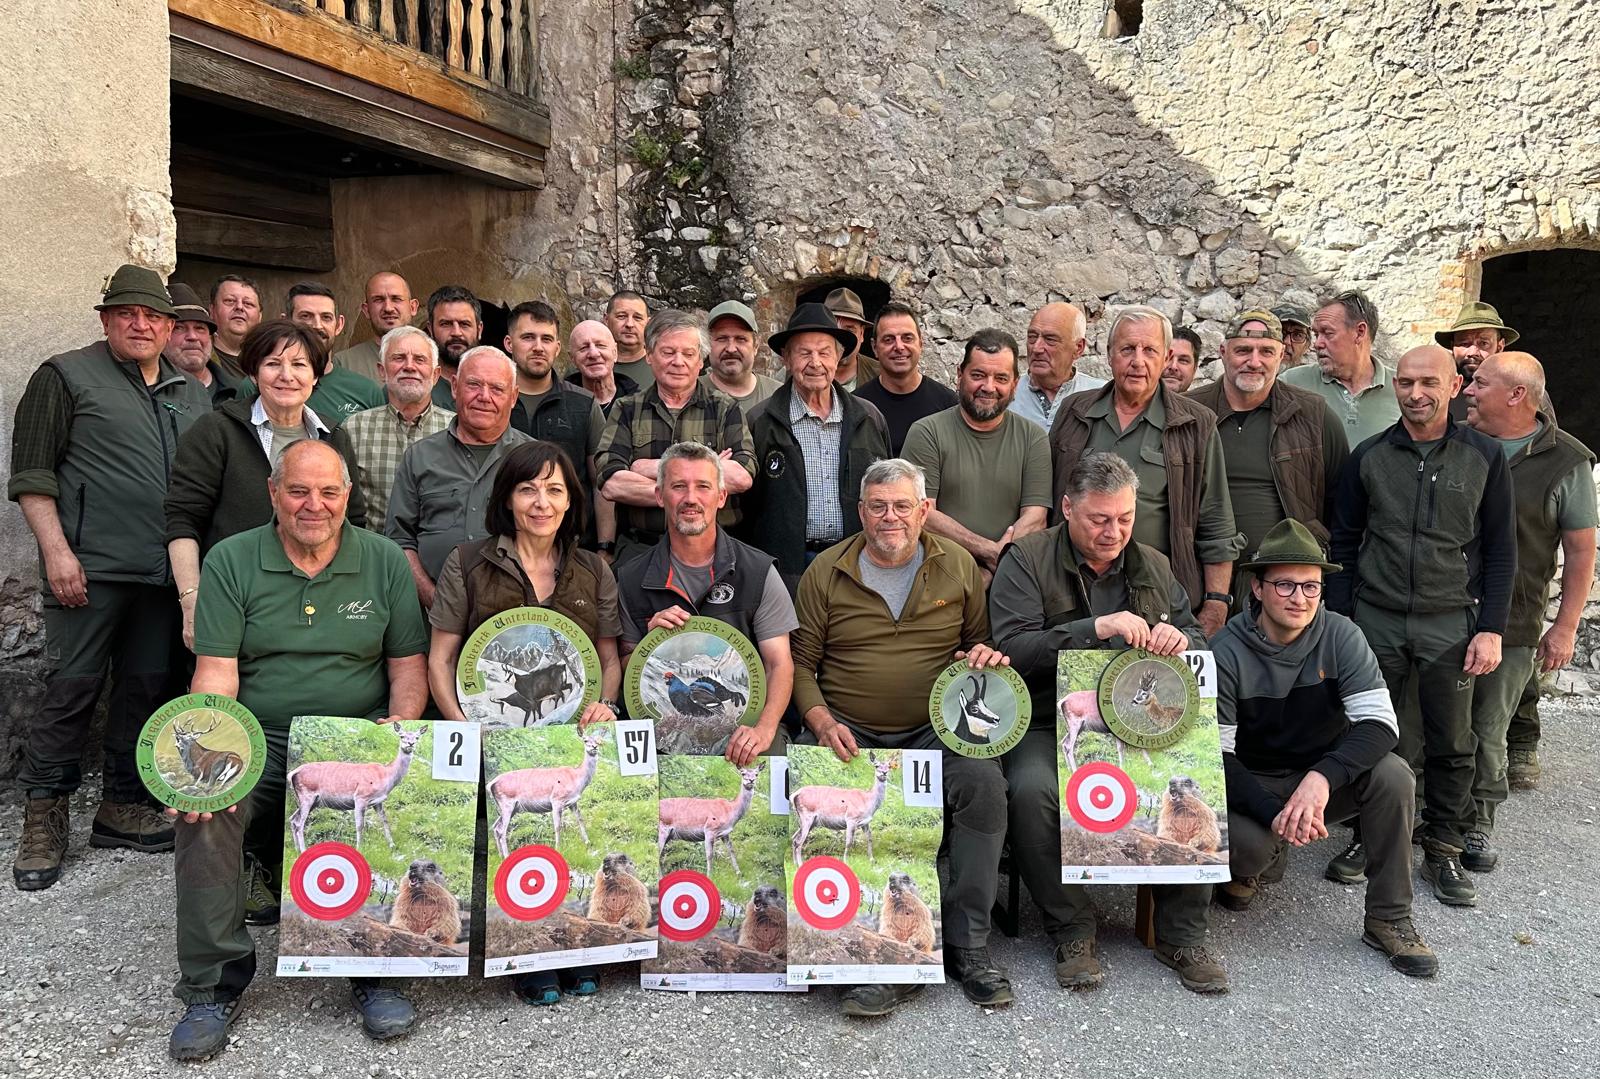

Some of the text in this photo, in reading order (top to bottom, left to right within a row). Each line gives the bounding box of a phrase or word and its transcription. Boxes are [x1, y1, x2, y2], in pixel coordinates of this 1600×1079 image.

[493, 611, 549, 630] Unterland
[554, 617, 579, 639] 2025
[692, 620, 719, 633] 2025
[1004, 668, 1026, 694] 2025
[251, 743, 264, 774] 2025
[448, 731, 463, 766] 2
[624, 730, 649, 764] 57
[912, 760, 932, 794] 14
